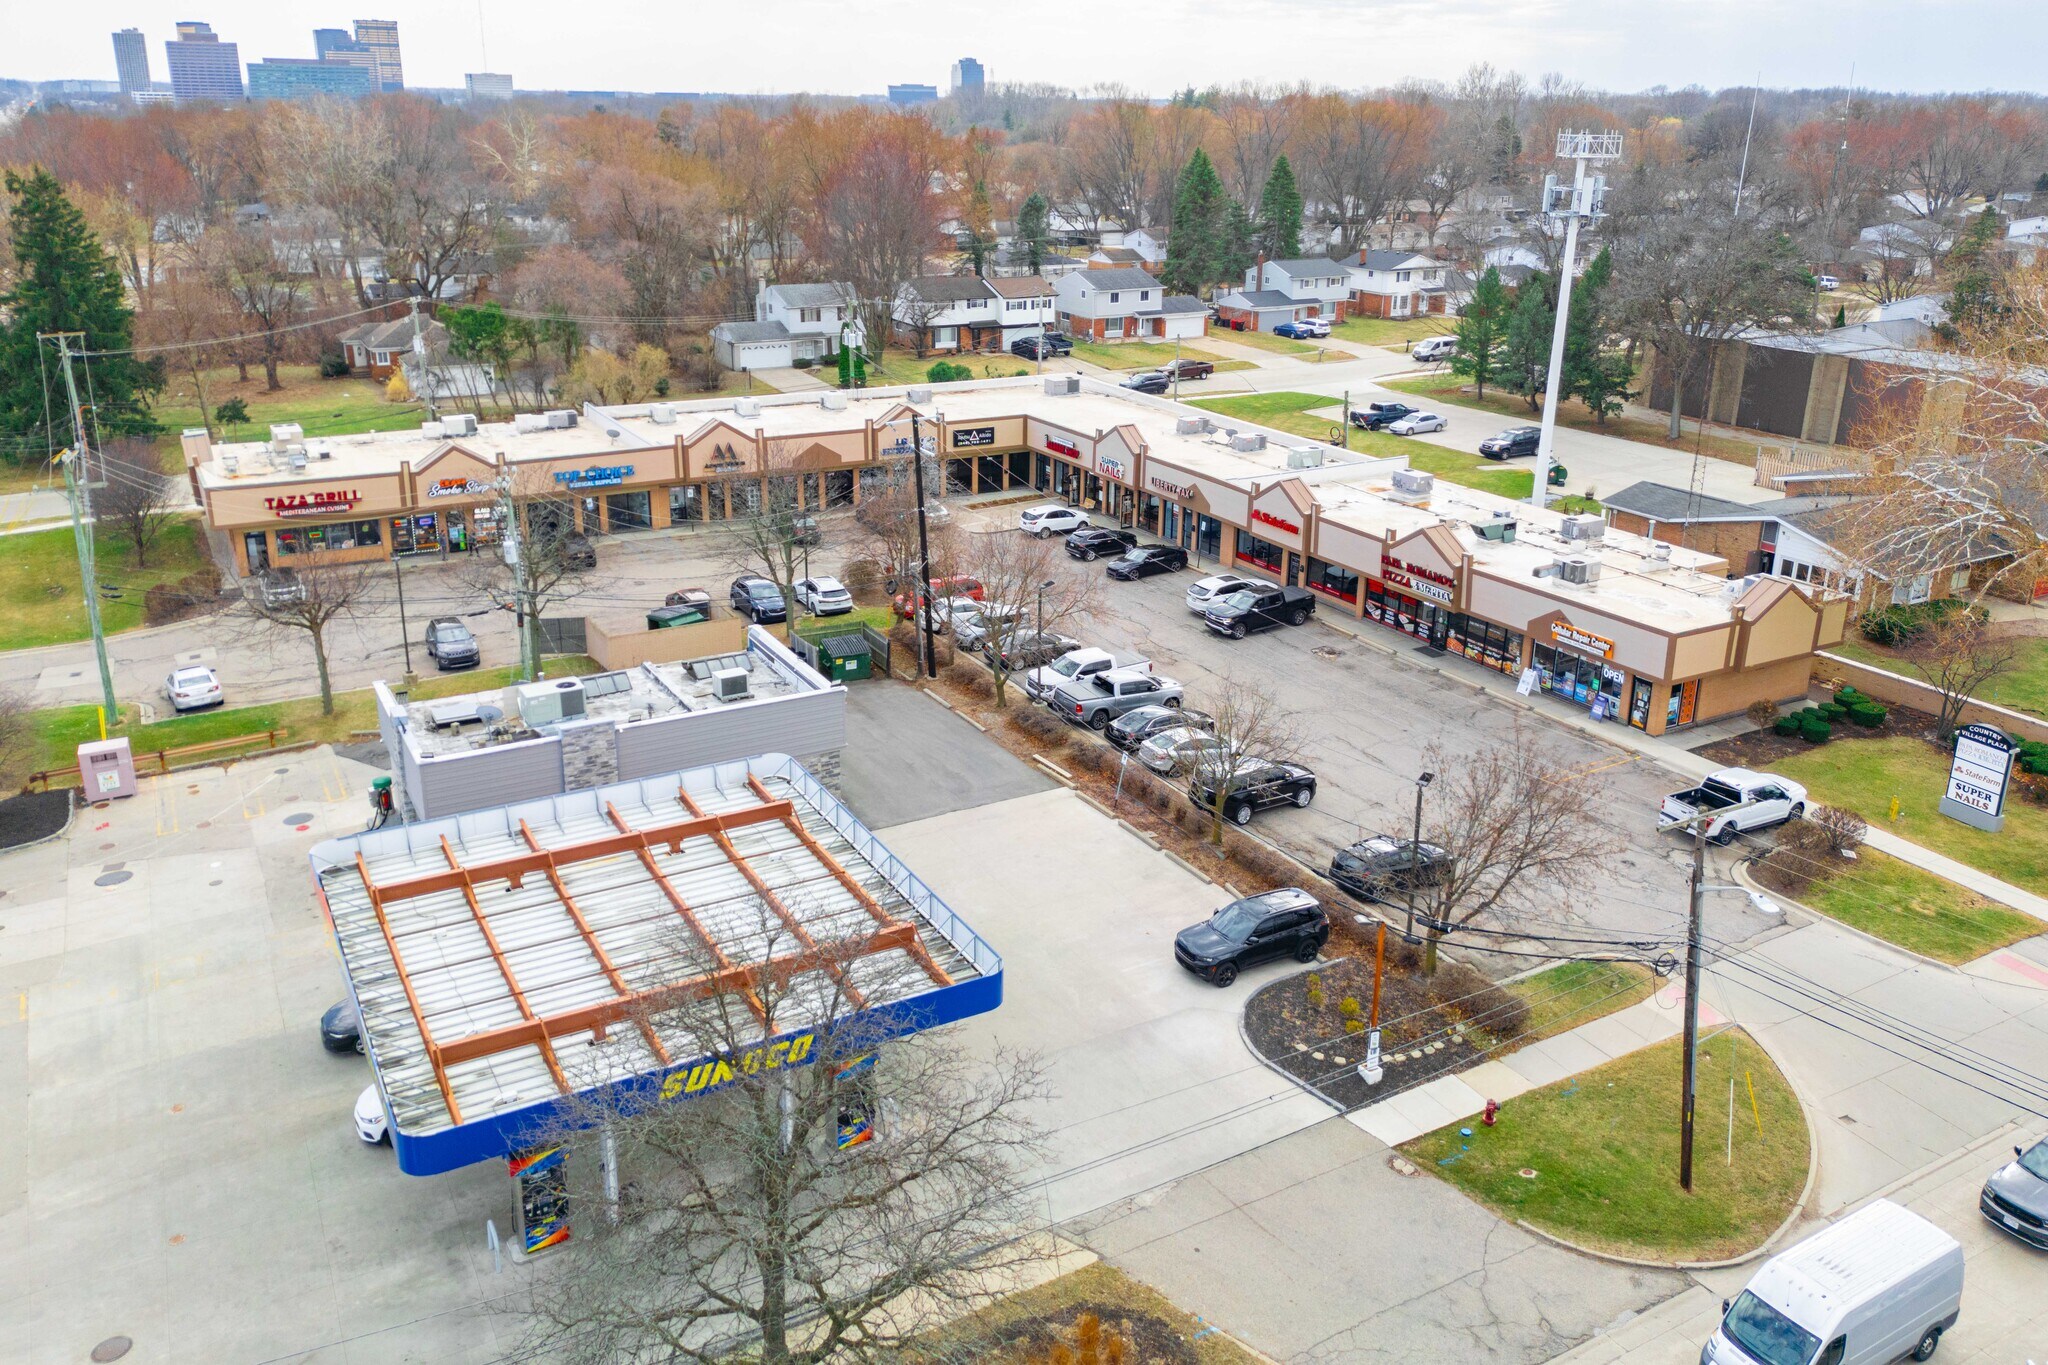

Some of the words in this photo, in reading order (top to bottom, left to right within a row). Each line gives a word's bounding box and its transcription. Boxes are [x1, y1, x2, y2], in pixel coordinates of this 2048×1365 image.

[1099, 462, 1122, 479] NAILS
[1101, 456, 1120, 469] SUPER
[553, 470, 580, 483] TOP
[585, 465, 635, 480] CHOICE
[595, 477, 622, 486] SUPPLIES
[428, 484, 462, 497] Smoke
[464, 479, 490, 494] Shop
[1151, 476, 1178, 494] LIBERTY
[1177, 486, 1191, 499] TAX
[264, 494, 309, 510] TAZA
[314, 489, 362, 506] GRILL
[326, 503, 350, 513] CUISINE
[1382, 569, 1412, 589] PIZZA
[1551, 623, 1572, 637] Cellular
[1572, 630, 1591, 644] Repair
[1591, 637, 1611, 651] Center
[1603, 668, 1625, 684] OPEN
[1961, 729, 1987, 744] VILLAGE
[1987, 739, 2008, 750] PLAZA
[1969, 725, 2002, 741] COUNTRY
[1955, 782, 1992, 803] SUPER
[1955, 791, 1990, 811] NAILS
[659, 1034, 815, 1101] SUNOCO
